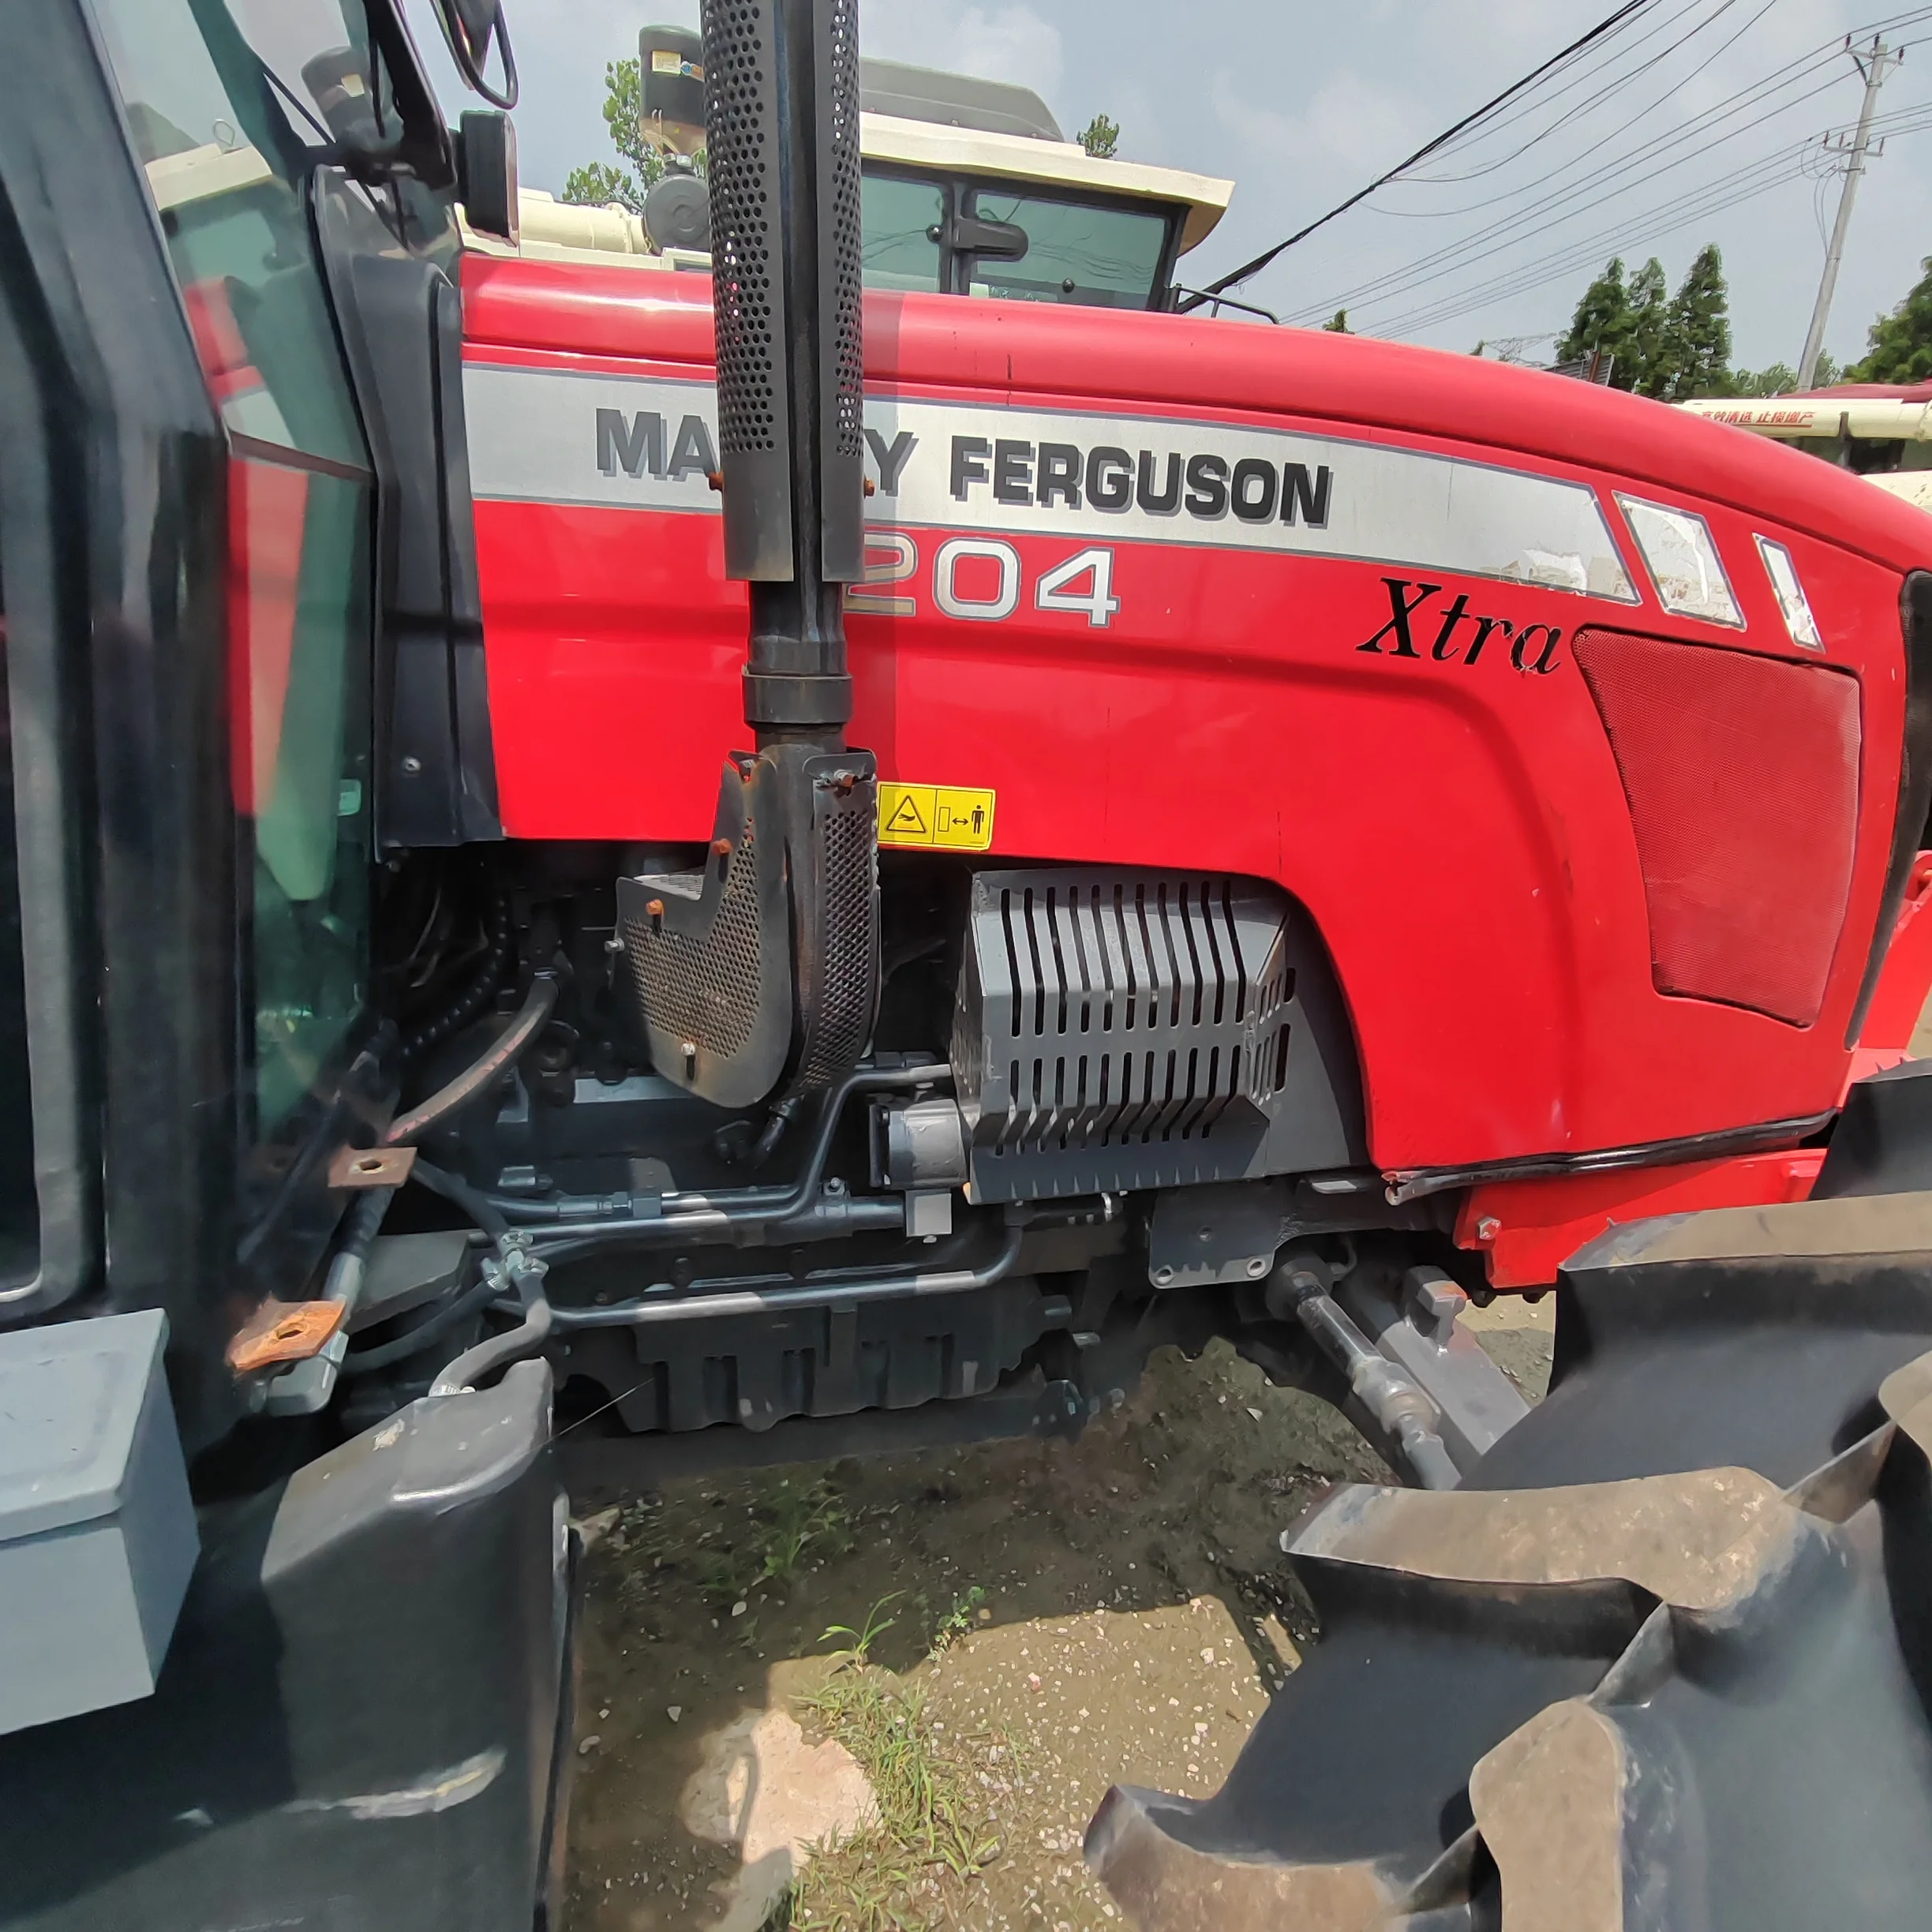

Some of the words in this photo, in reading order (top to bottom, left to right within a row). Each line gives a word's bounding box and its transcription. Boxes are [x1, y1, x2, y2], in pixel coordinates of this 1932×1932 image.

[596, 407, 919, 497] MAY
[950, 435, 1333, 530] FERGUSON
[1355, 576, 1562, 675] Xtra
